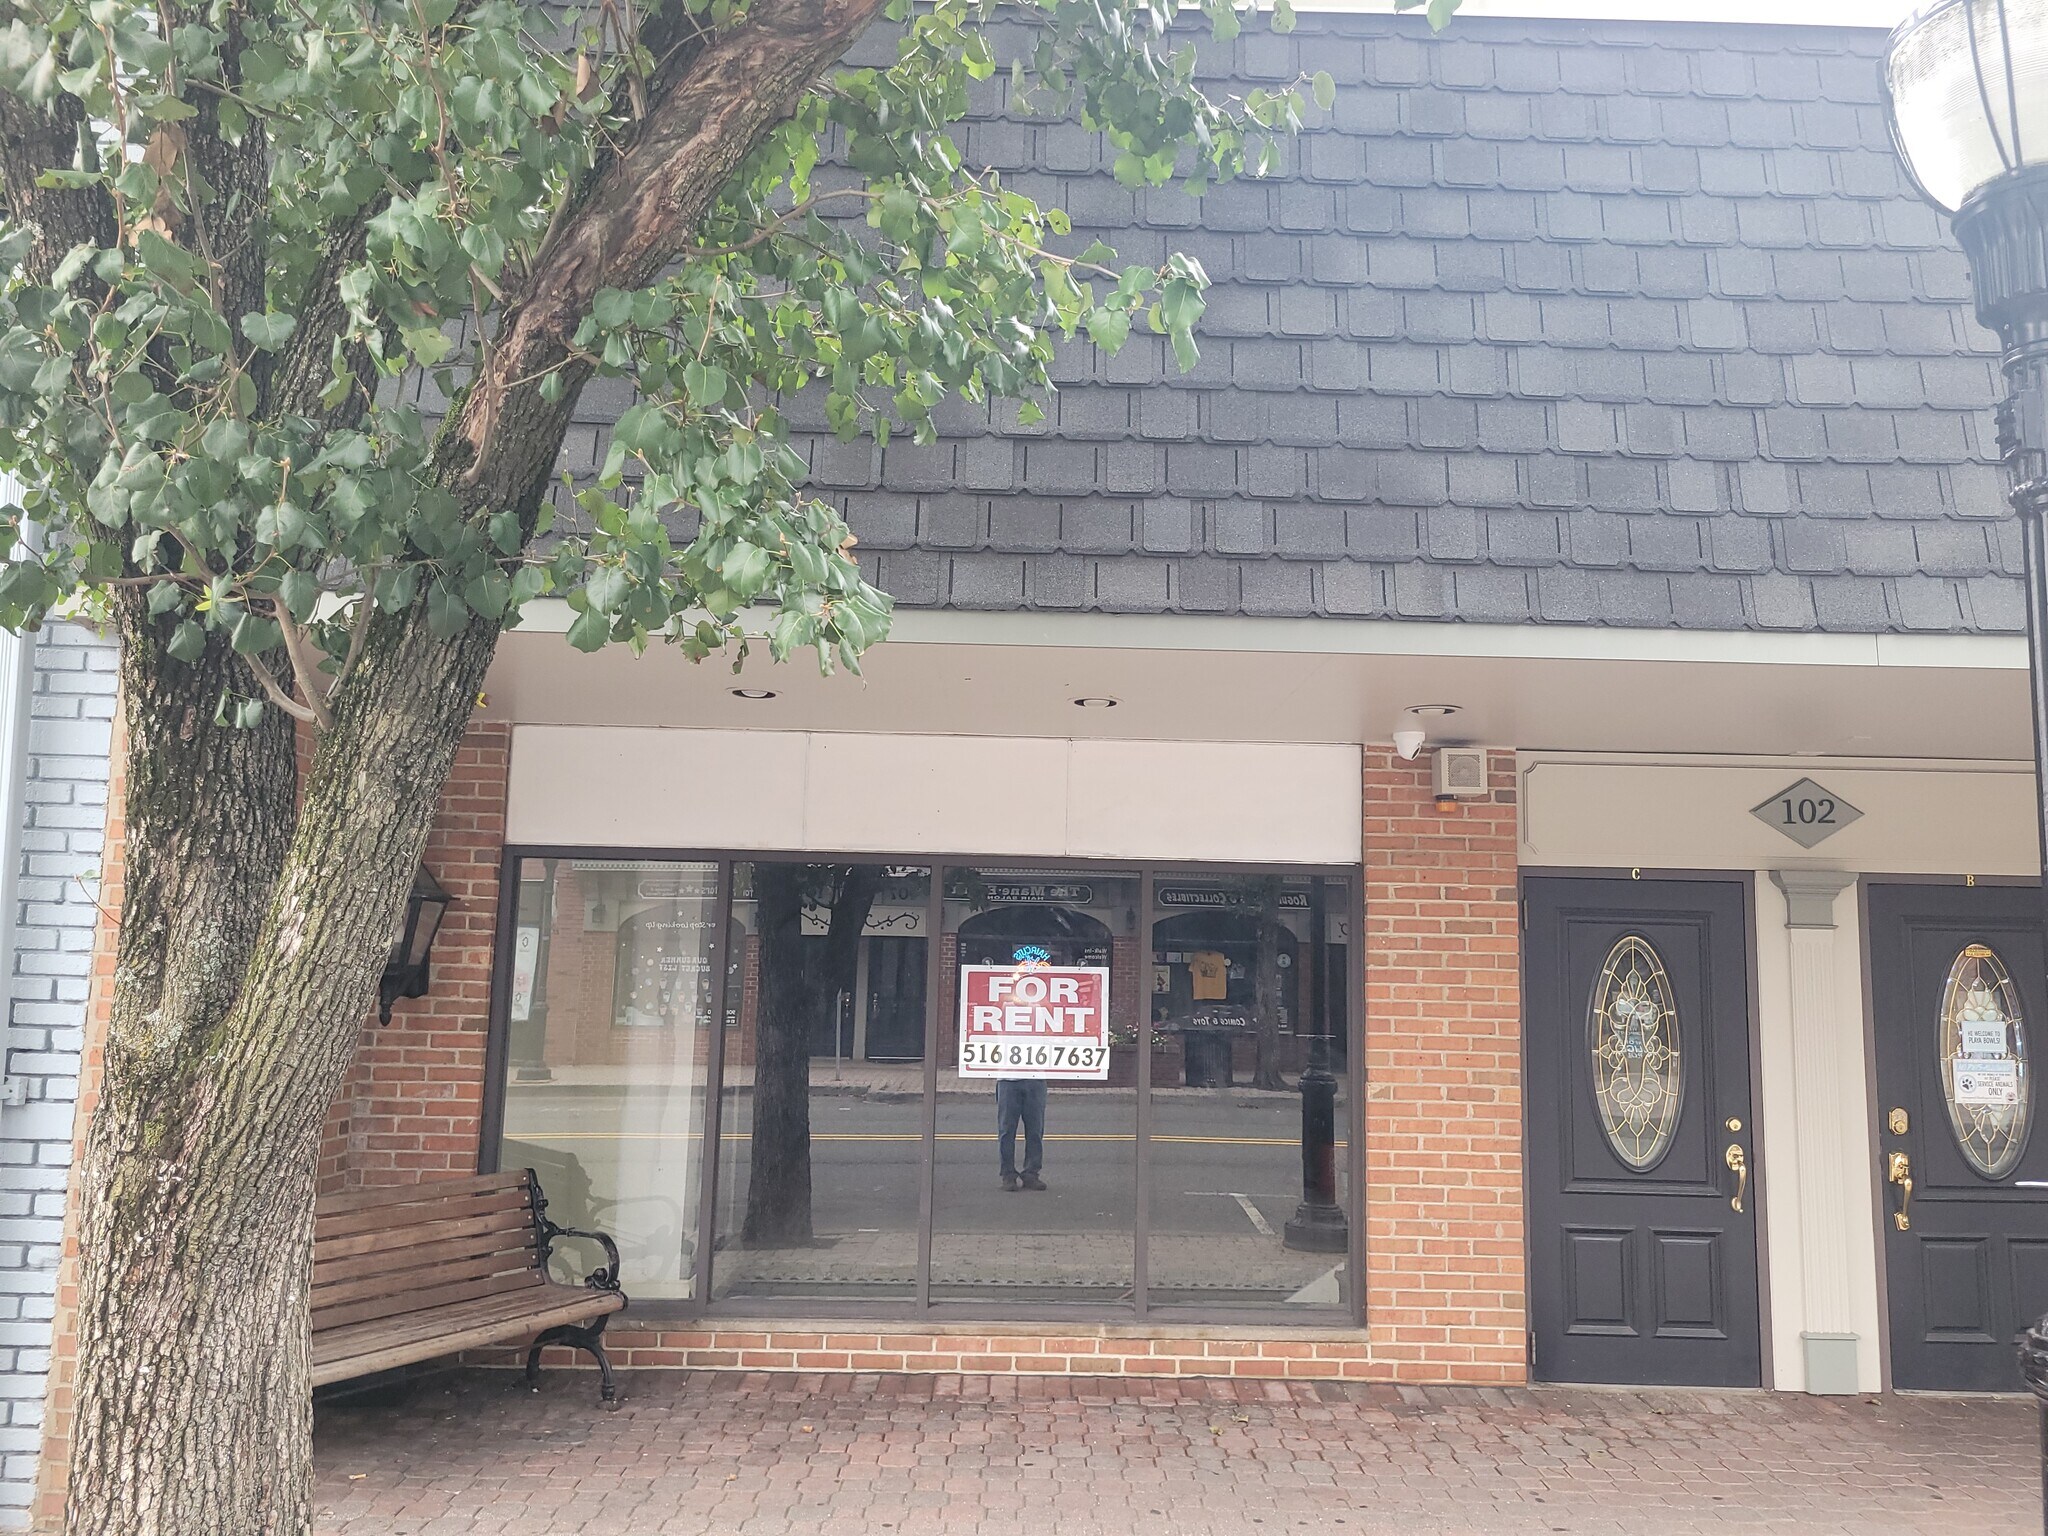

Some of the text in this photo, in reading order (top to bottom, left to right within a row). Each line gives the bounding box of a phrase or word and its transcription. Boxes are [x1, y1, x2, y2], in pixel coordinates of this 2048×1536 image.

[1781, 799, 1836, 824] 102
[1631, 868, 1641, 880] C
[1965, 875, 1975, 887] B
[988, 976, 1080, 1004] FOR
[973, 1005, 1095, 1033] RENT
[963, 1043, 1107, 1067] 516 816 7637
[1988, 1087, 2003, 1096] ONLY
